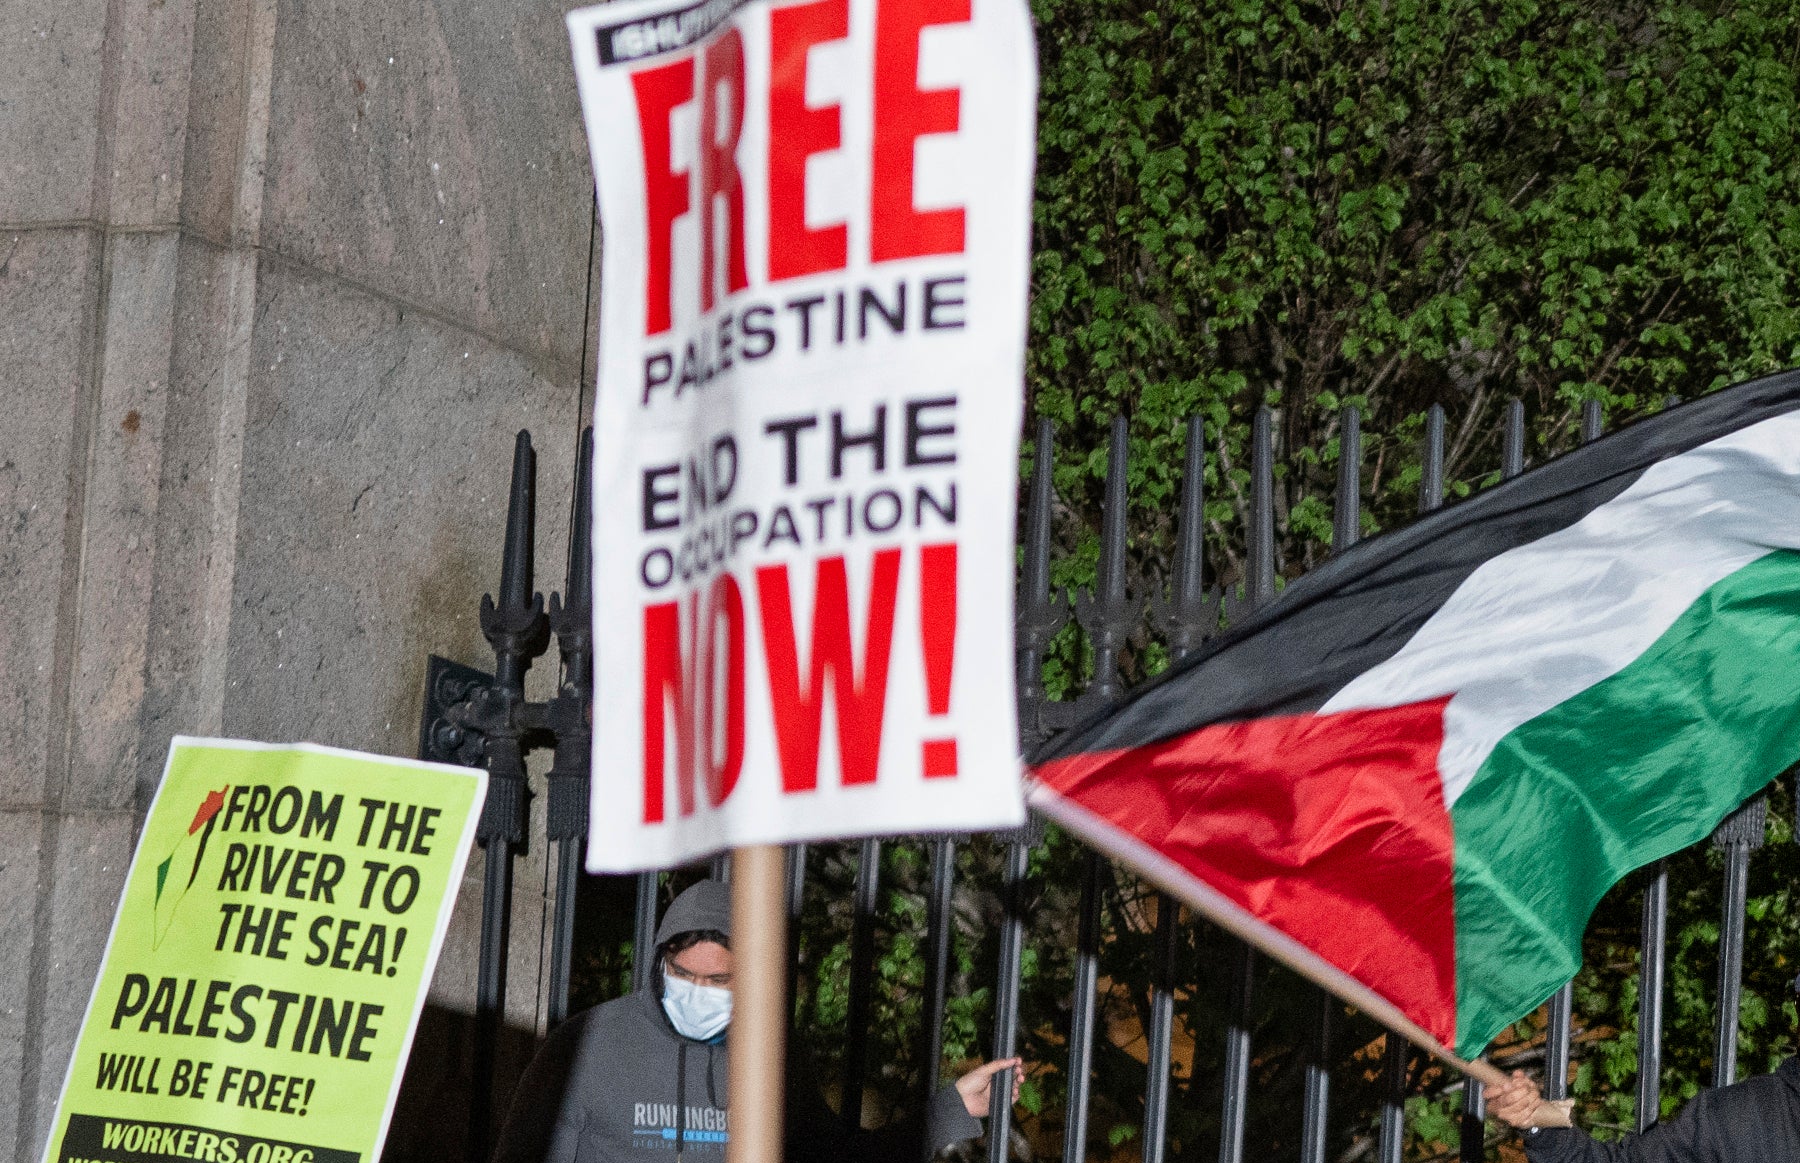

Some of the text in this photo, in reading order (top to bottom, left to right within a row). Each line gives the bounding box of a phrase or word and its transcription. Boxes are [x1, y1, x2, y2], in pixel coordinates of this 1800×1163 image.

[630, 0, 973, 337] FREE
[641, 276, 967, 406] PALESTINE
[642, 396, 959, 532] END THE
[640, 482, 959, 590] OCCUPATION
[642, 541, 959, 826] NOW!
[221, 784, 442, 856] FROM THE
[217, 842, 421, 915] RIVER TO
[214, 903, 408, 978] THE SEA!
[110, 973, 385, 1063] PALESTINE
[95, 1052, 316, 1117] WILL BE FREE!
